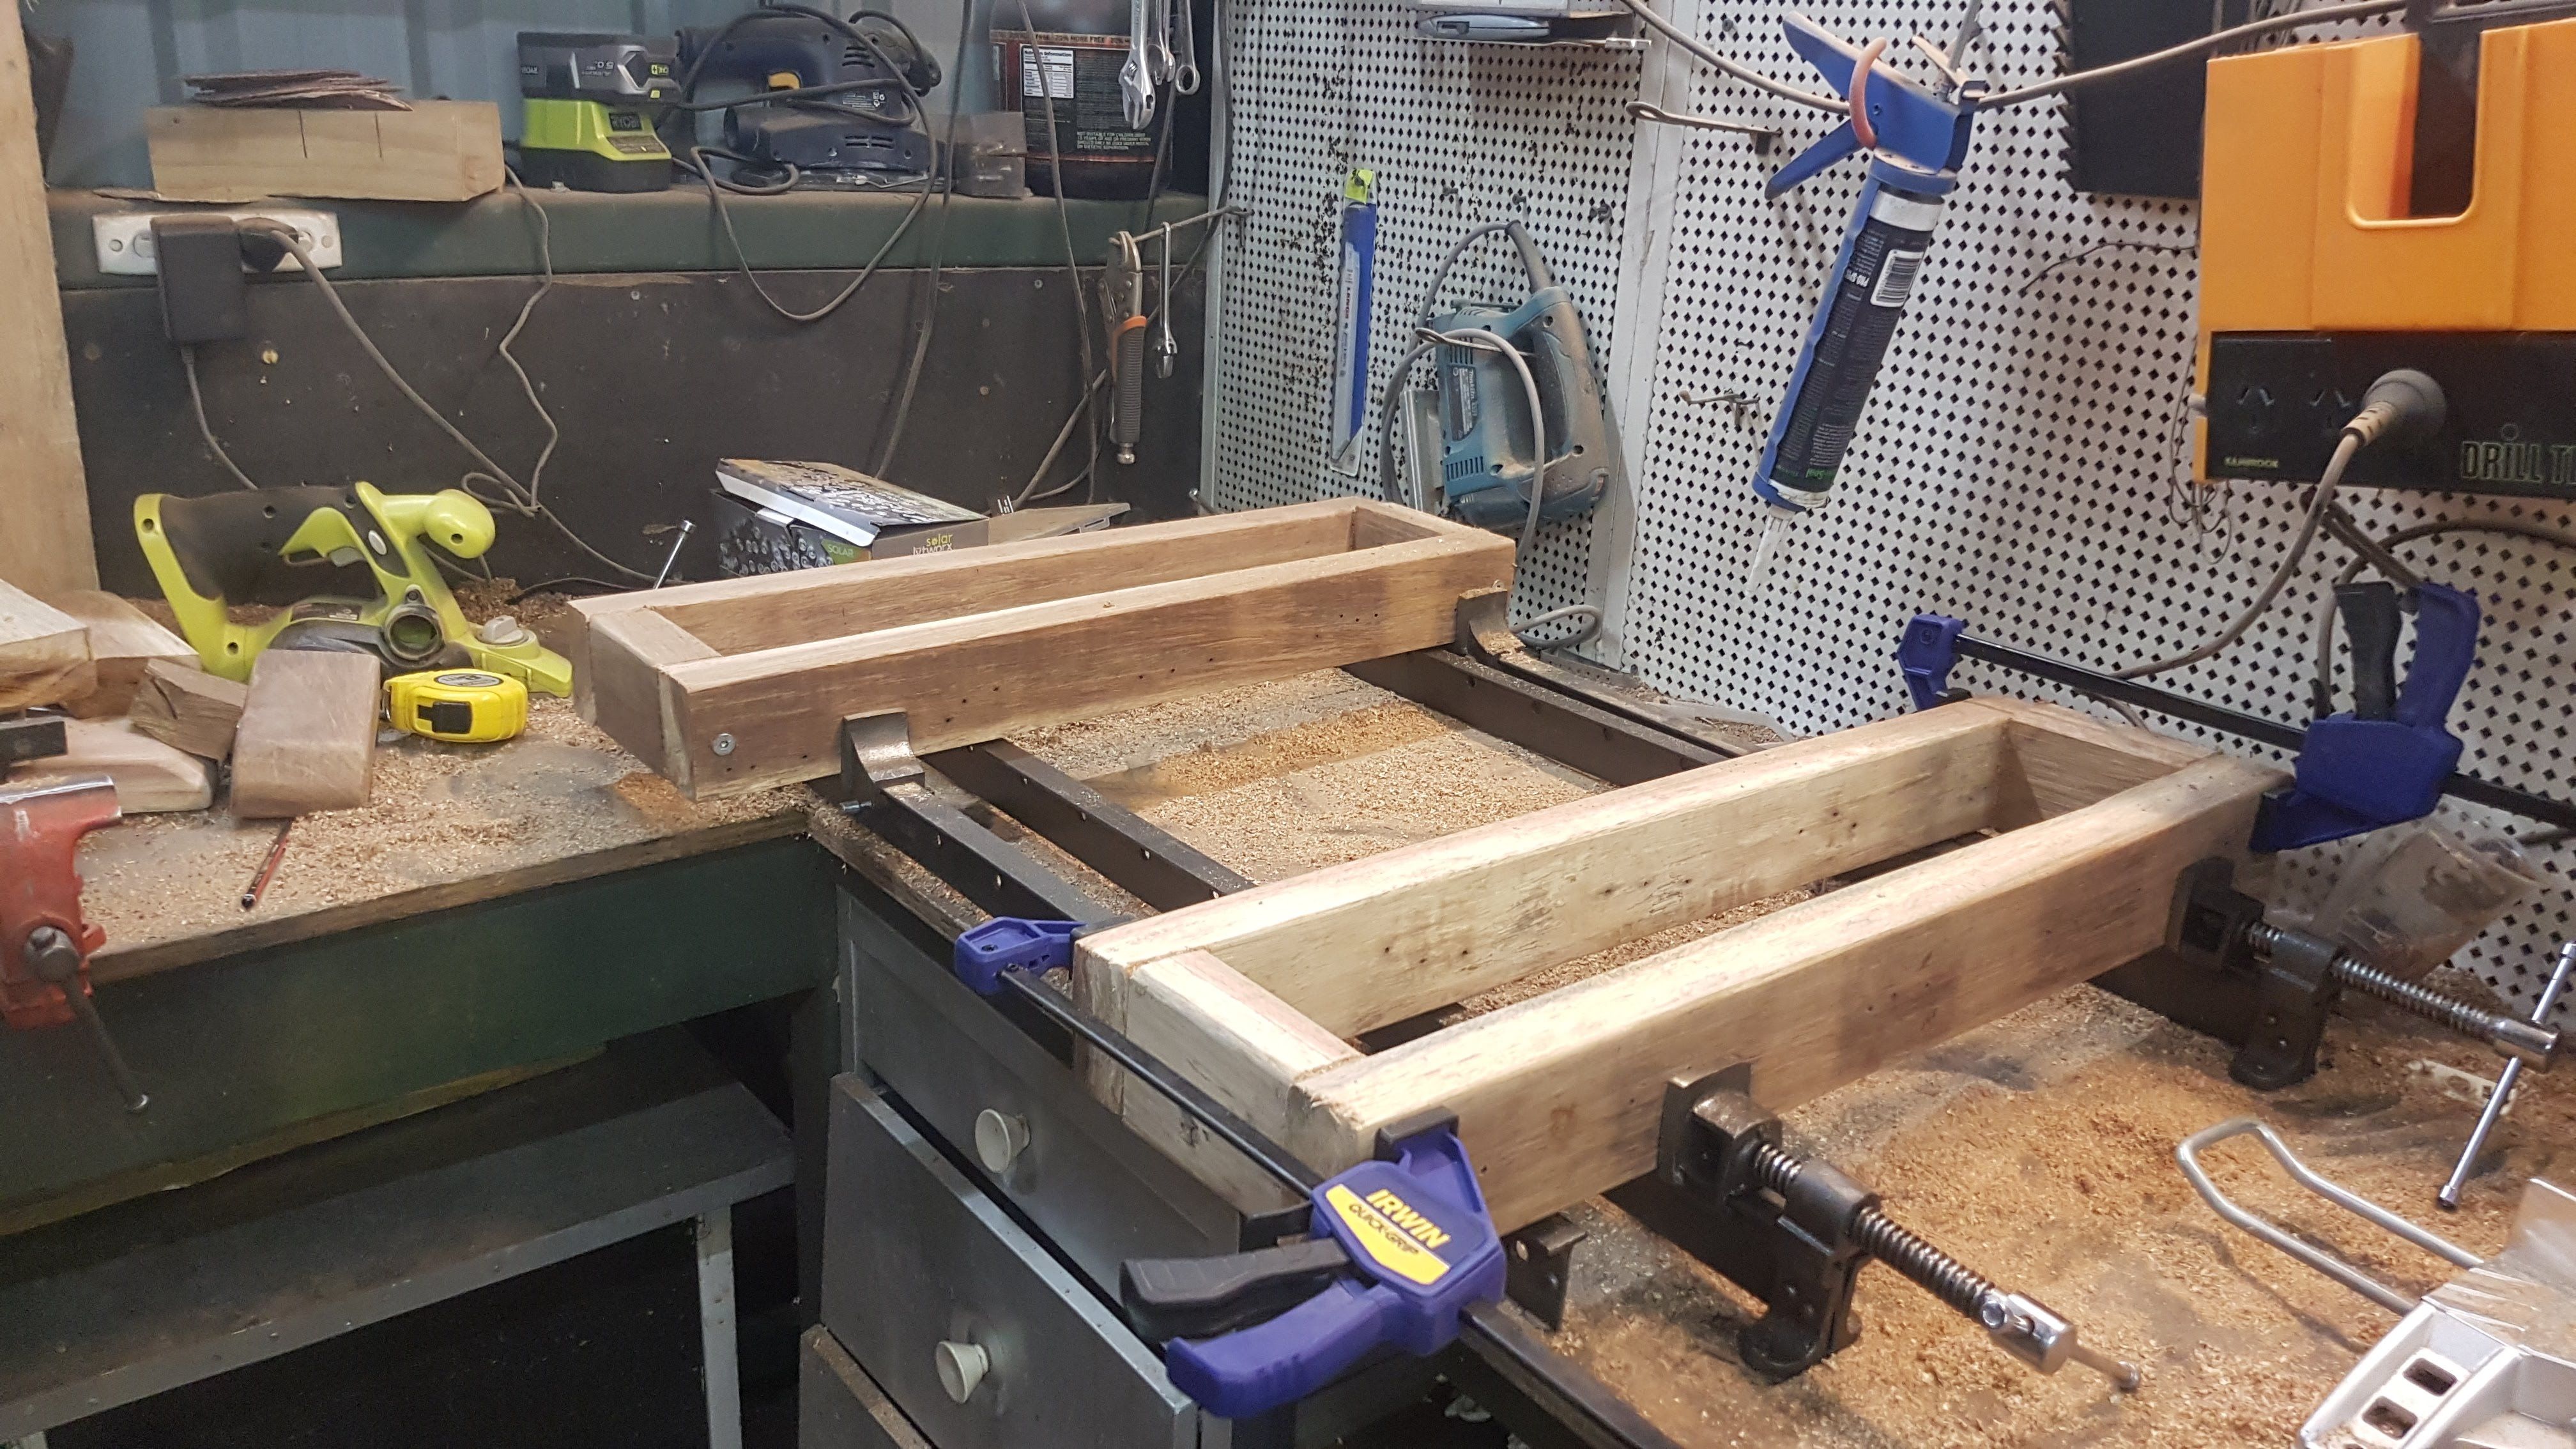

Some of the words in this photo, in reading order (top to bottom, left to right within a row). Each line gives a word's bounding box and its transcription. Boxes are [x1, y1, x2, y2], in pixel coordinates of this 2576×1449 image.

[2461, 441, 2543, 484] DRILL
[827, 544, 854, 558] SOLAR
[926, 533, 953, 547] solar
[1365, 1188, 1452, 1249] IRWIN
